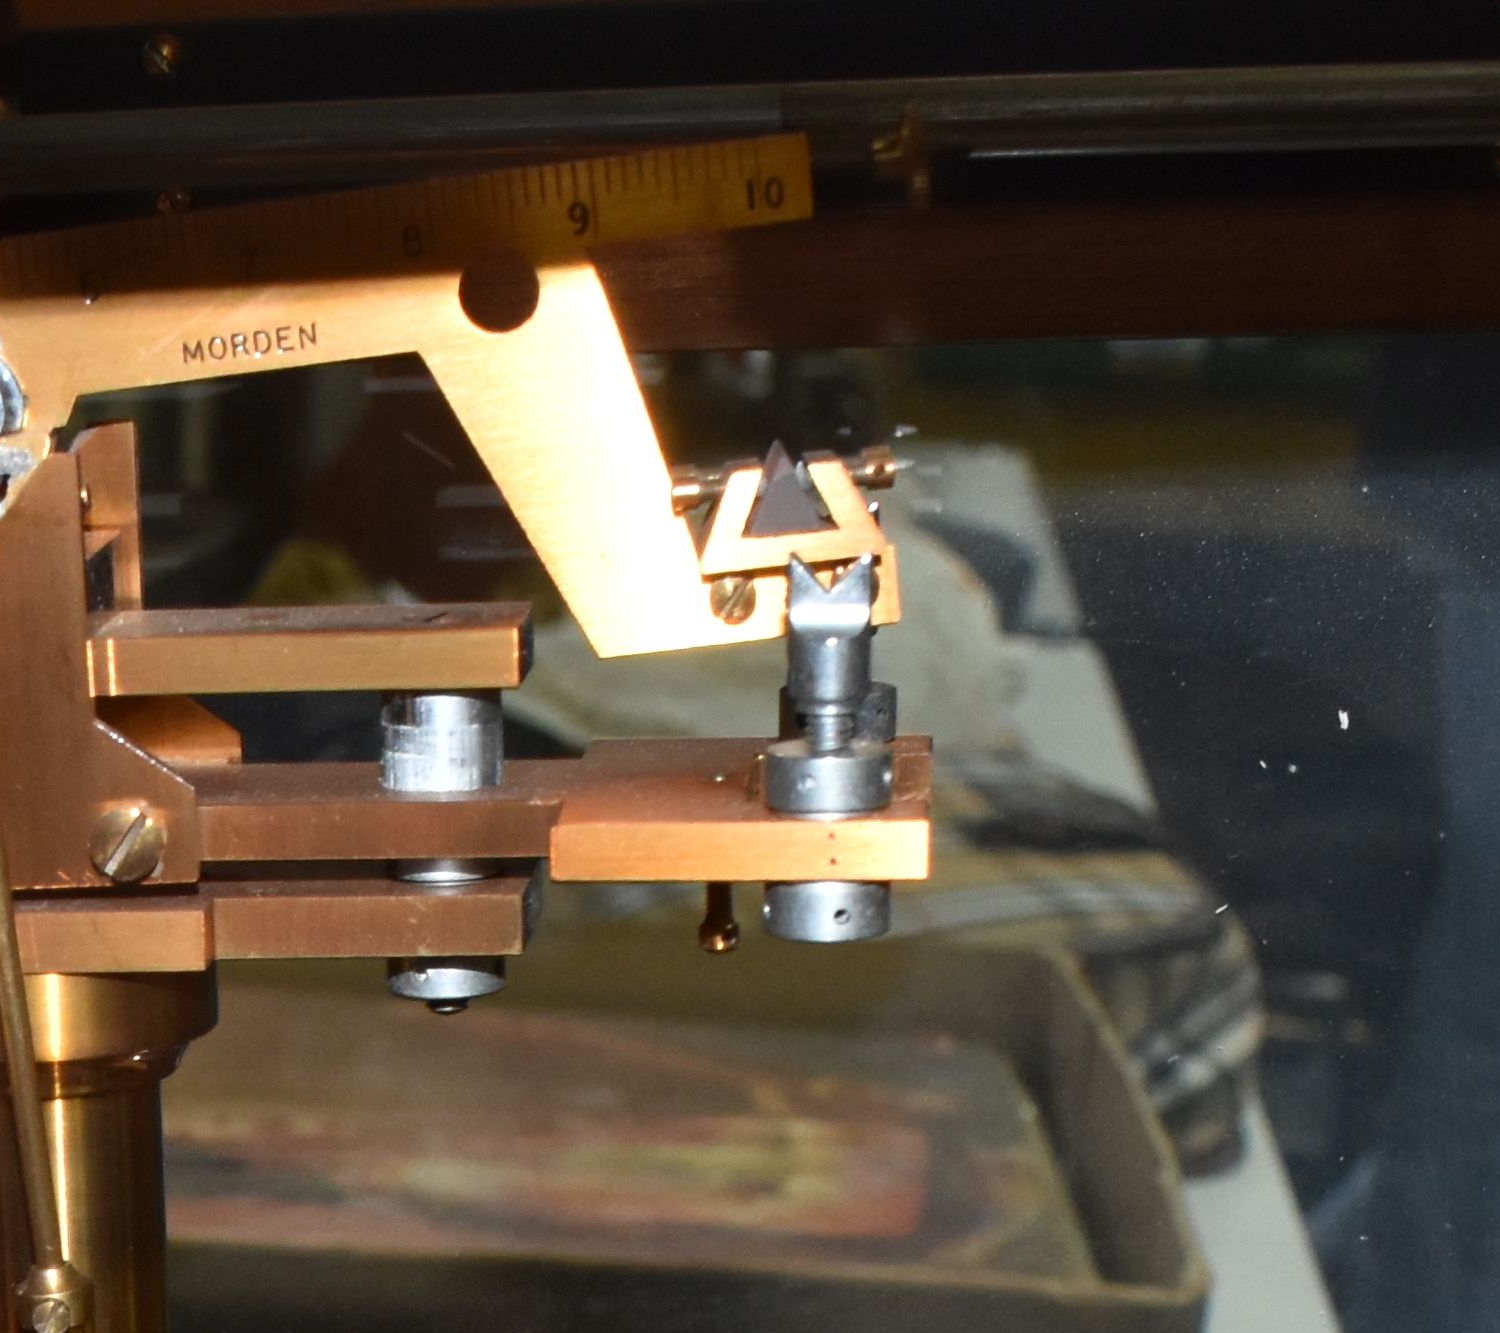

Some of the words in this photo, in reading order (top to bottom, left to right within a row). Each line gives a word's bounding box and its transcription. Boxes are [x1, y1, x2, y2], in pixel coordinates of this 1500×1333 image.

[401, 223, 422, 258] 8
[567, 201, 589, 237] 9
[745, 176, 785, 211] 10
[182, 323, 317, 364] MORDEN
